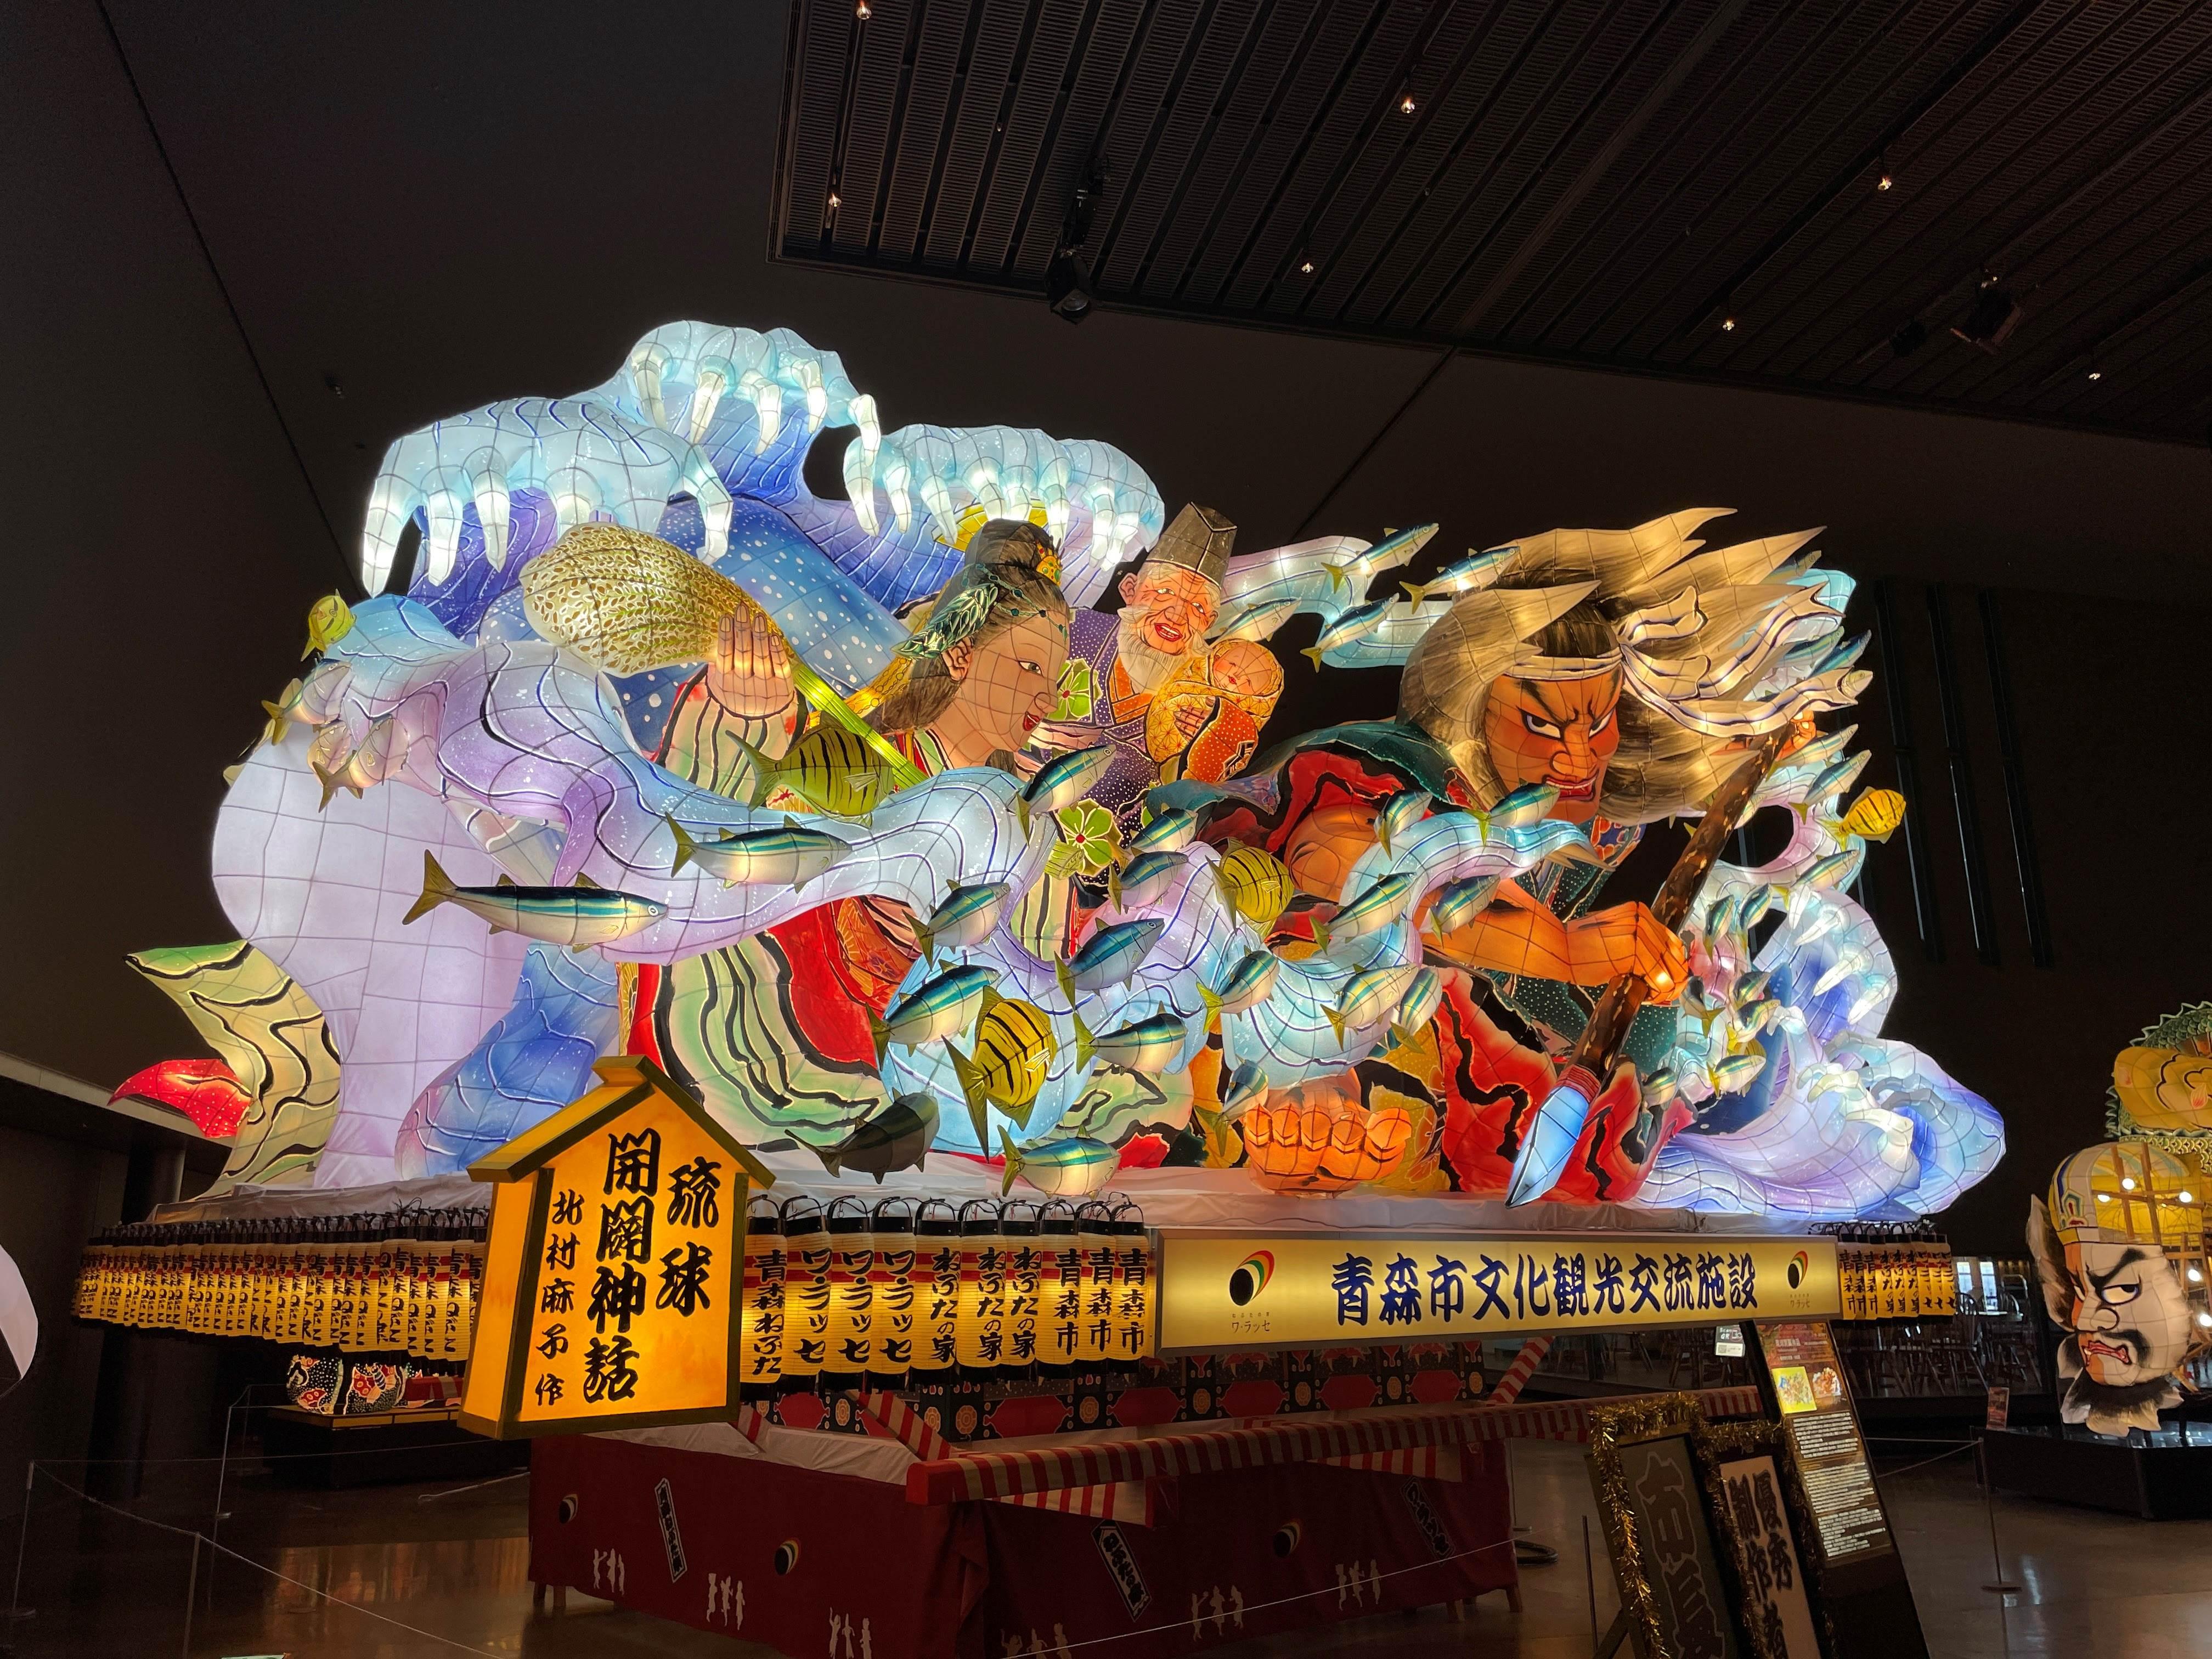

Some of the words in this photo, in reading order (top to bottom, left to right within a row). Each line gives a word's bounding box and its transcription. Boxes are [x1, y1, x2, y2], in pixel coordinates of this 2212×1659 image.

[656, 1155, 722, 1317] 琉球
[1331, 1252, 1758, 1325] 青森市文化観光交流施設
[750, 1249, 787, 1375] 青森ねぶた
[930, 1248, 960, 1362] ねぶたの家
[977, 1247, 1006, 1361] ねぶたの家
[1009, 1246, 1042, 1359] ねぶたの家
[1053, 1248, 1081, 1355] 青森市
[1085, 1247, 1115, 1352] 青森市
[1117, 1248, 1148, 1355] 青森市
